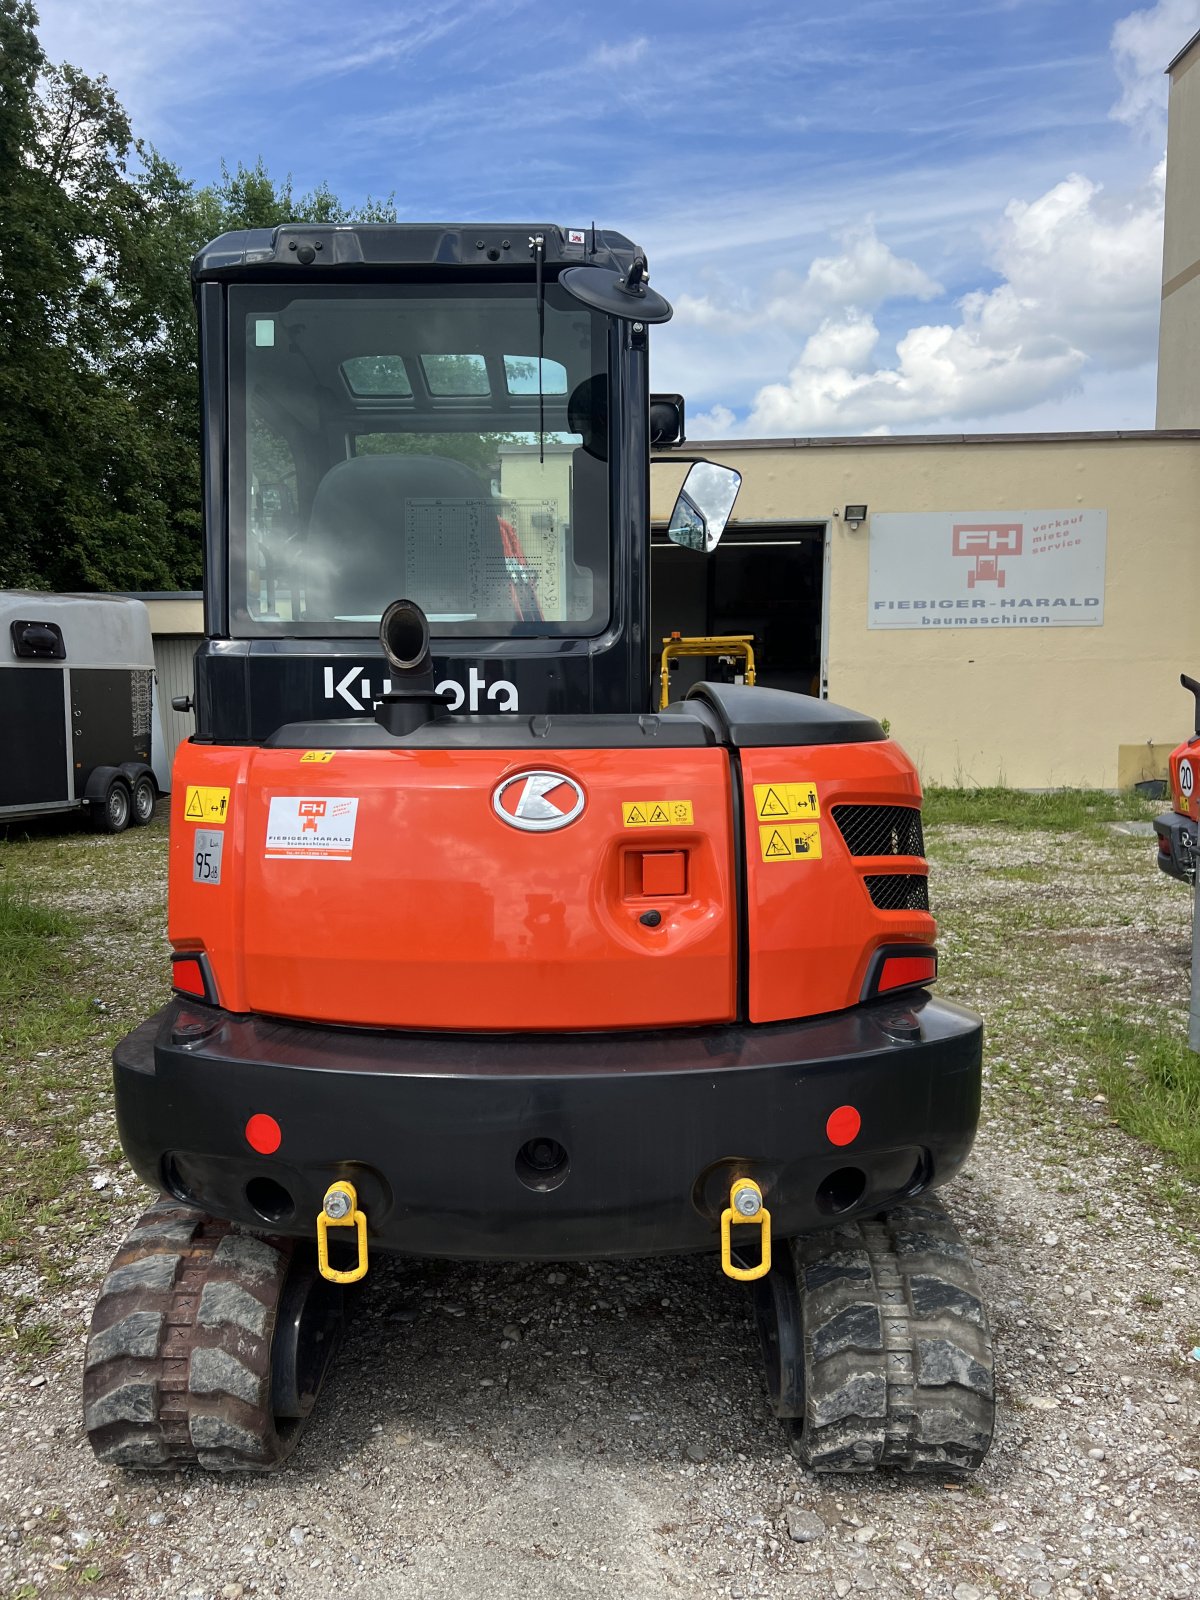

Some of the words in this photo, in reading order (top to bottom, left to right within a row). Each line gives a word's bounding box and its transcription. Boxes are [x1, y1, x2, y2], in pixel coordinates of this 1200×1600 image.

[1032, 514, 1084, 533] verkauf
[958, 529, 1016, 550] FH
[1032, 530, 1070, 543] miete
[1031, 539, 1082, 554] service
[921, 614, 1050, 625] baumaschinen
[323, 666, 519, 712] Kuota
[1181, 766, 1192, 791] 20
[301, 803, 324, 814] FH
